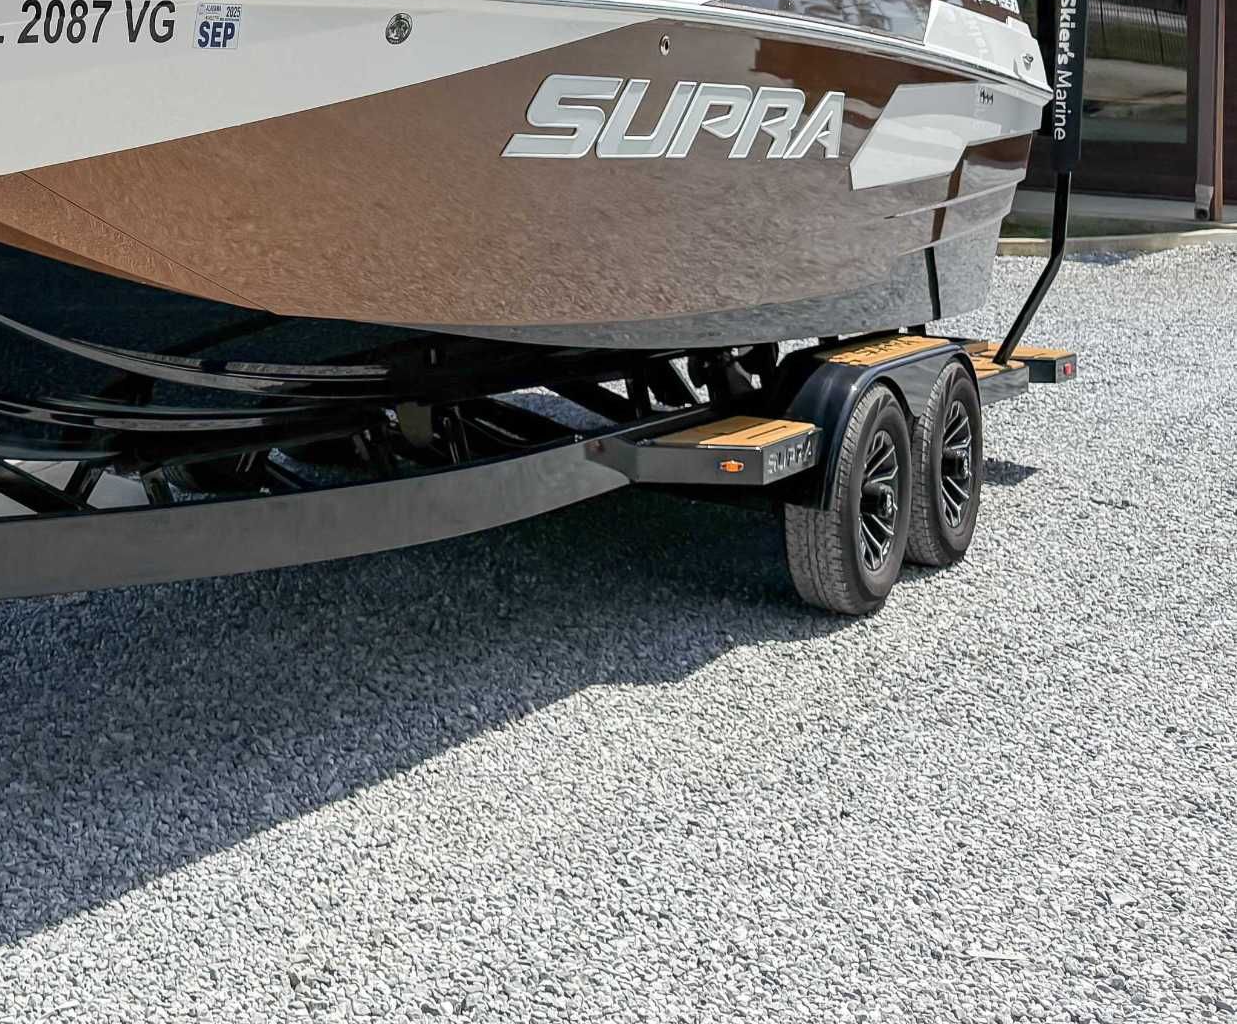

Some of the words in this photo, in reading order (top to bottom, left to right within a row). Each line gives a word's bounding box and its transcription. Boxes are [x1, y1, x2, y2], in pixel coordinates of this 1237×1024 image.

[17, 0, 113, 44] 2087
[124, 0, 176, 43] VG
[197, 20, 236, 48] SEP
[500, 74, 846, 160] SUPRA
[1053, 70, 1073, 141] Marine
